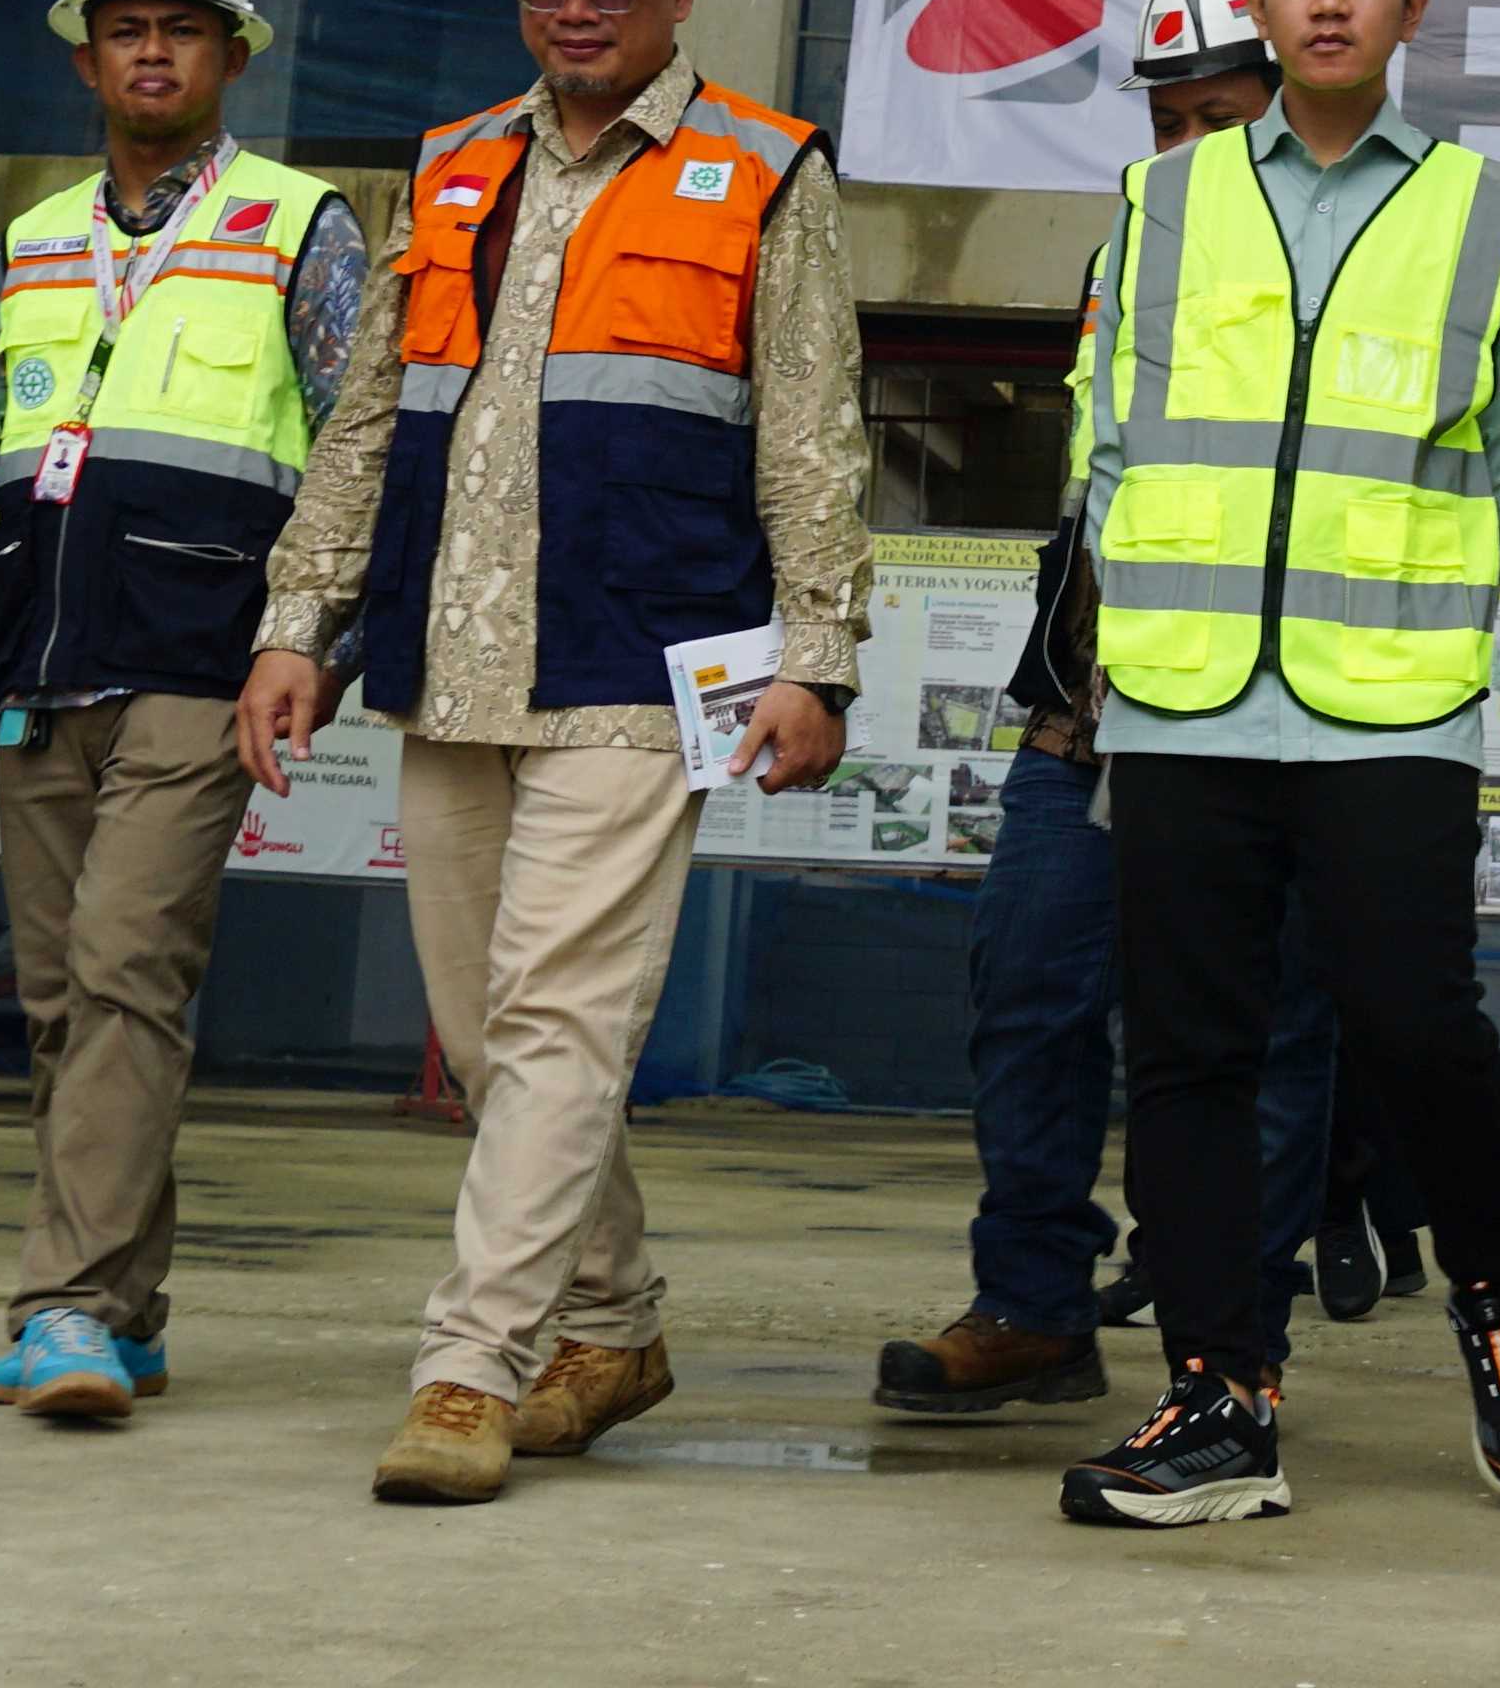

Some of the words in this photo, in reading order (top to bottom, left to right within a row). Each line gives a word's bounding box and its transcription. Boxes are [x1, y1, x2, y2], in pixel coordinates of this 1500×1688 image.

[906, 538, 1010, 553] PEKERJAAN
[880, 551, 960, 564] JENDRAL
[964, 553, 1016, 566] CIPTA
[895, 575, 959, 590] TERBAN
